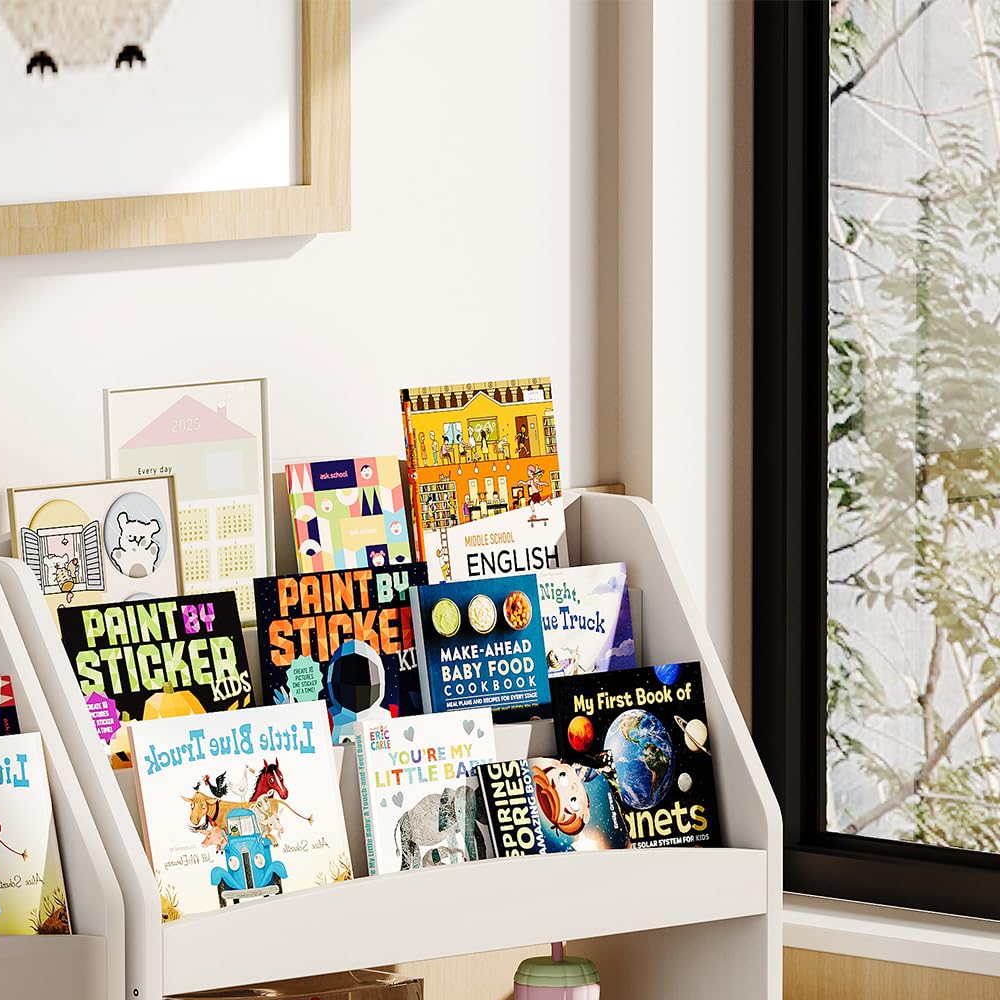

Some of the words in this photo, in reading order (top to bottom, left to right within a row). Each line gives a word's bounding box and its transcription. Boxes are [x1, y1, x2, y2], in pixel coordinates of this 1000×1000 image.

[171, 417, 201, 433] 2025
[138, 467, 158, 476] Every
[160, 466, 173, 474] day
[464, 534, 488, 548] MIDDLE
[490, 532, 515, 545] SCHOOL
[466, 544, 560, 576] ENGLISH
[278, 570, 372, 617] PAINT
[376, 571, 410, 604] BY
[540, 582, 580, 604] Night,
[82, 602, 178, 648] PAINT
[181, 602, 216, 634] BY
[542, 616, 558, 630] ue
[559, 606, 606, 633] Truck
[398, 648, 418, 672] KI
[440, 639, 532, 662] MAKE-AHEAD
[76, 636, 241, 697] STICKER
[442, 662, 482, 682] BABY
[488, 657, 535, 678] FOOD
[210, 670, 252, 702] KIDS
[444, 676, 537, 696] COOKBOOK
[574, 695, 594, 716] My
[598, 690, 633, 710] First
[636, 684, 672, 705] Book
[676, 682, 692, 700] of
[388, 746, 446, 766] YOU'RE
[450, 744, 473, 759] MY
[374, 764, 438, 788] LITTLE
[520, 760, 534, 793] BOYS
[487, 763, 520, 858] SPIRING
[502, 760, 534, 851] ORIES
[528, 796, 547, 855] AMAZING
[625, 801, 708, 840] anets
[638, 841, 658, 849] SOLAR
[658, 838, 682, 846] SYSTEM
